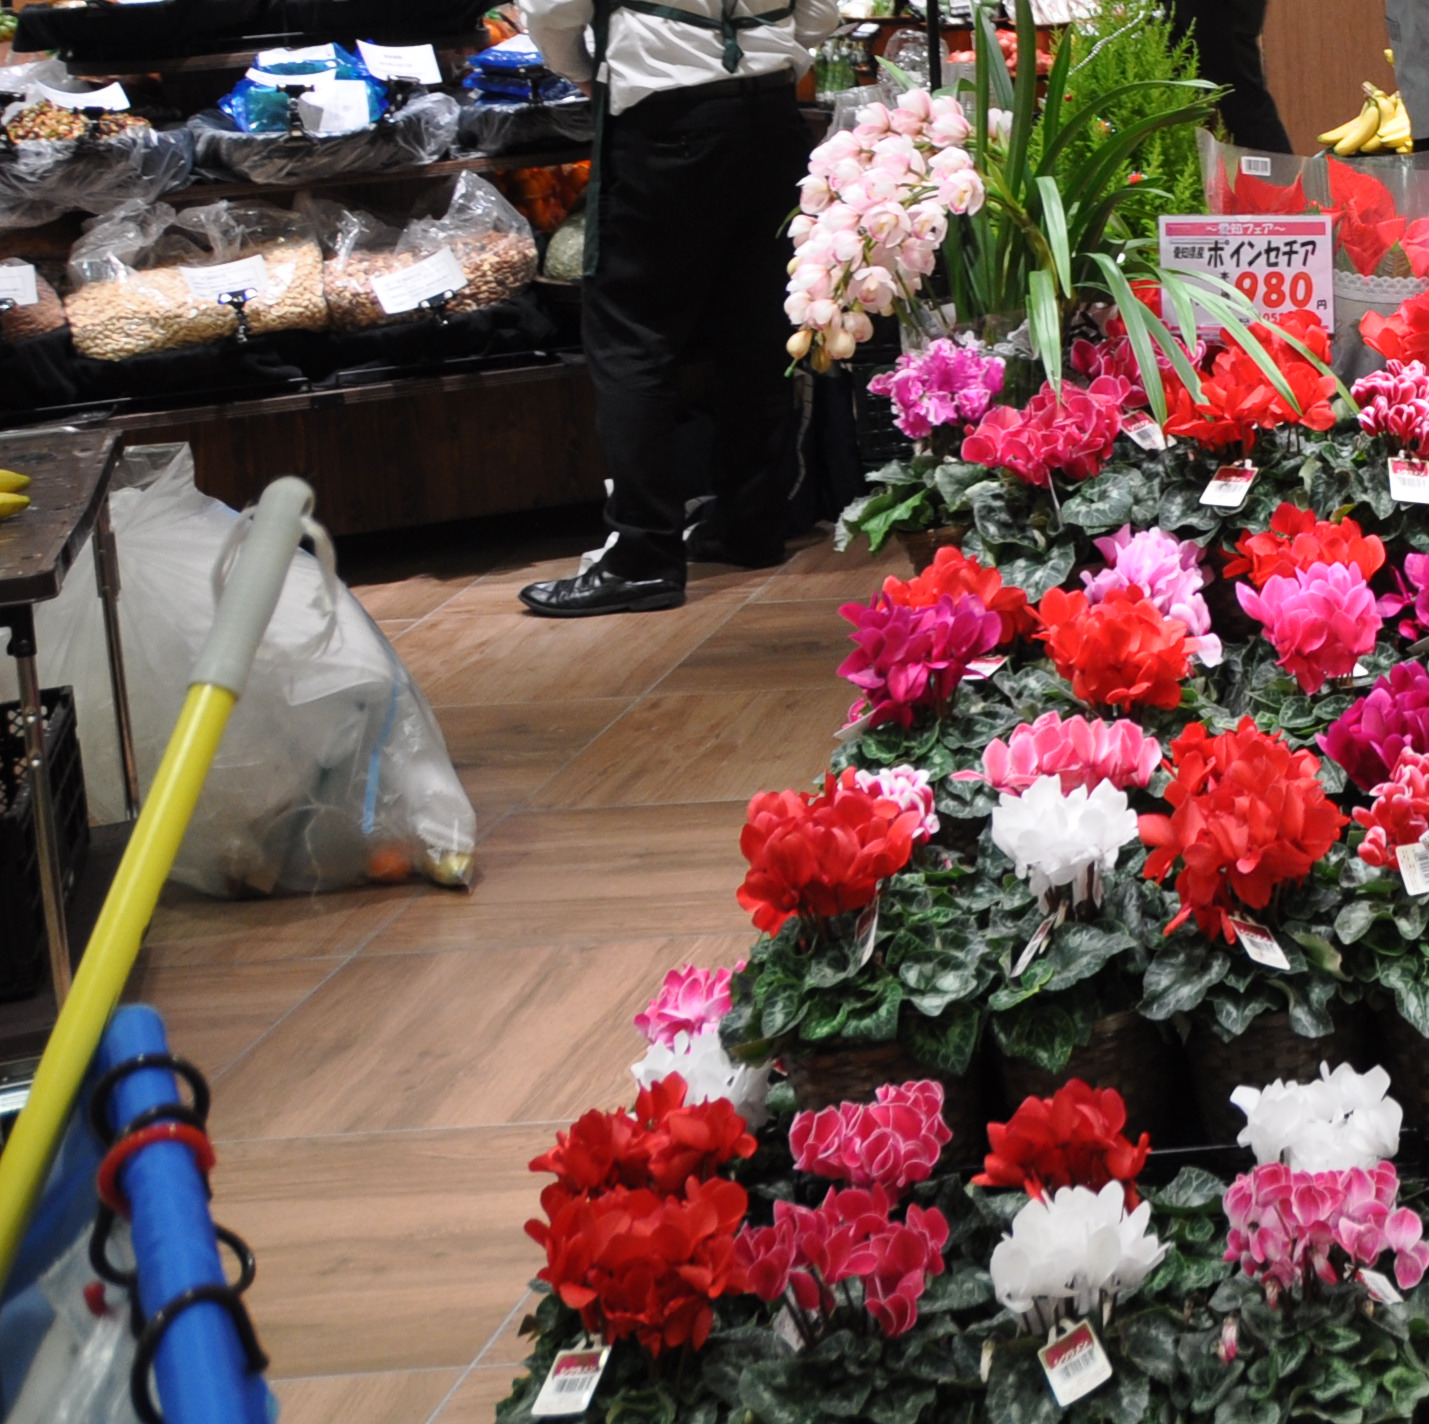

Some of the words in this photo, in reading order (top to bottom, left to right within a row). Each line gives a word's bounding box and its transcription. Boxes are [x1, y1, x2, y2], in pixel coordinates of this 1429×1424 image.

[1173, 246, 1204, 259] 愛知県産
[1207, 239, 1317, 268] ポインセチア
[1235, 271, 1313, 308] 980
[1316, 299, 1327, 310] 円
